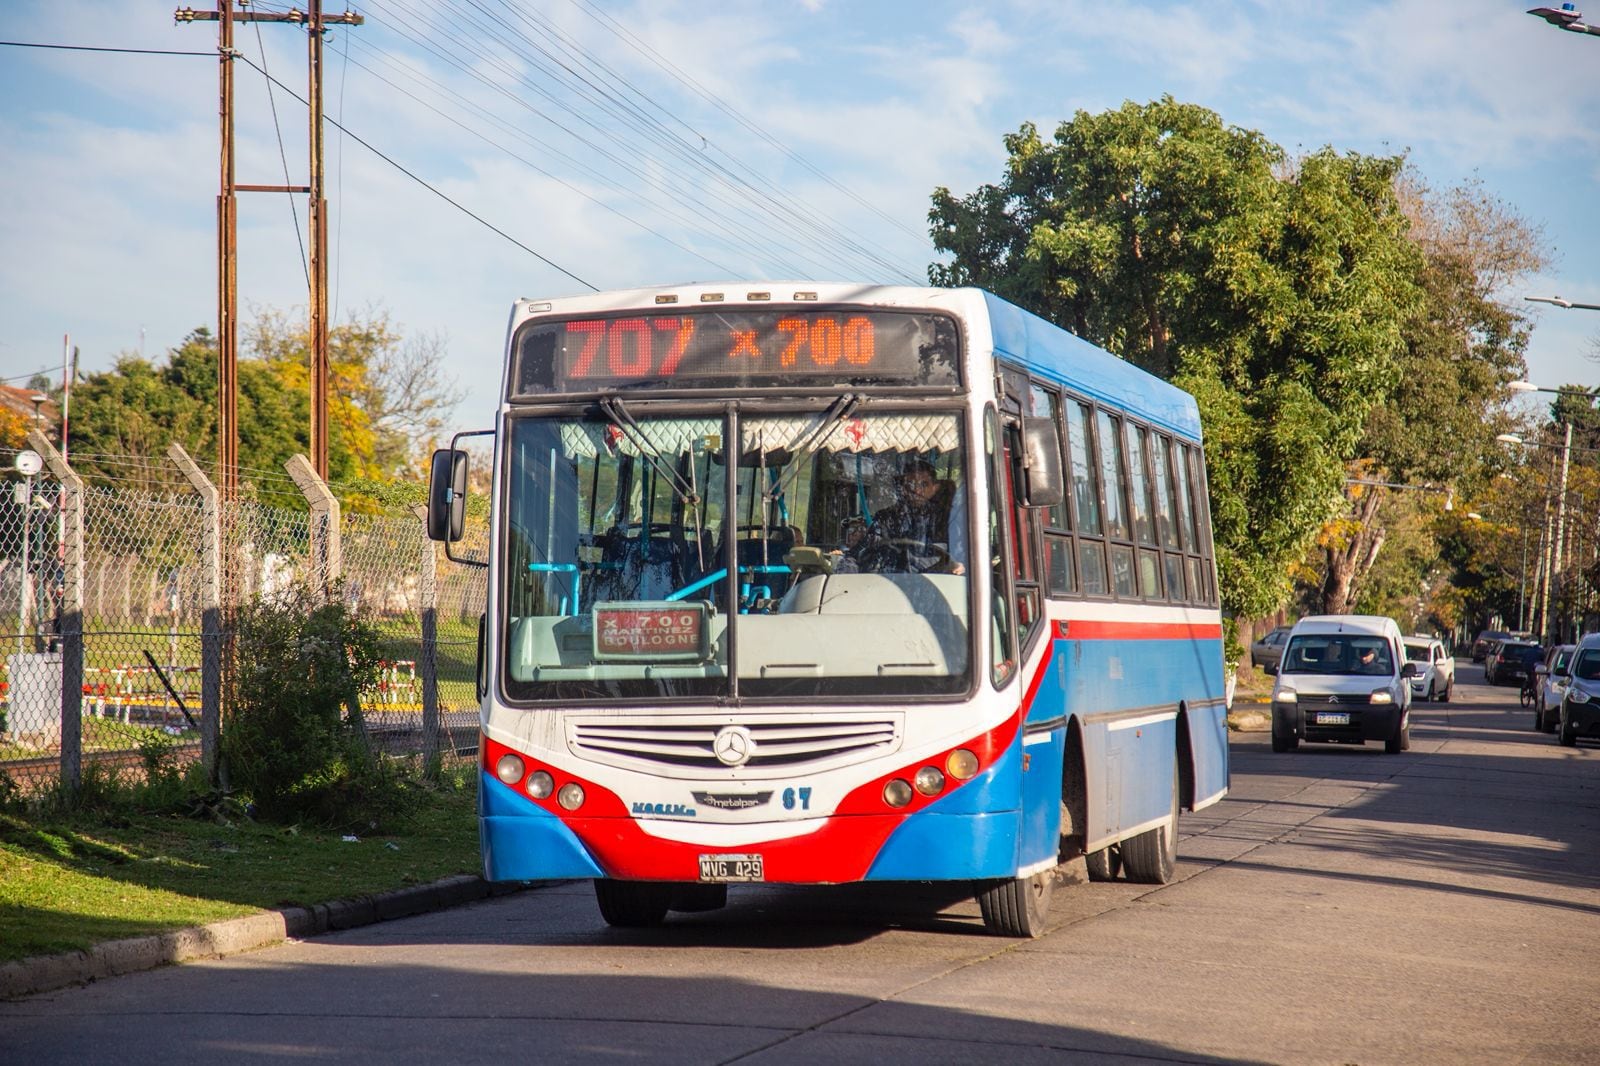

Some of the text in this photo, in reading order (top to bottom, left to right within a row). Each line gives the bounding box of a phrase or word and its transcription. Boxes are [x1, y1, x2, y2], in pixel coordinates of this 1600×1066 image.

[565, 319, 694, 378] 707
[775, 316, 875, 368] 700
[638, 615, 693, 628] 700
[603, 627, 694, 636] MARTINEZ
[604, 635, 699, 646] BOULOGNE
[713, 797, 759, 809] metalpar
[782, 787, 812, 811] 67
[701, 861, 761, 877] MVG 429
